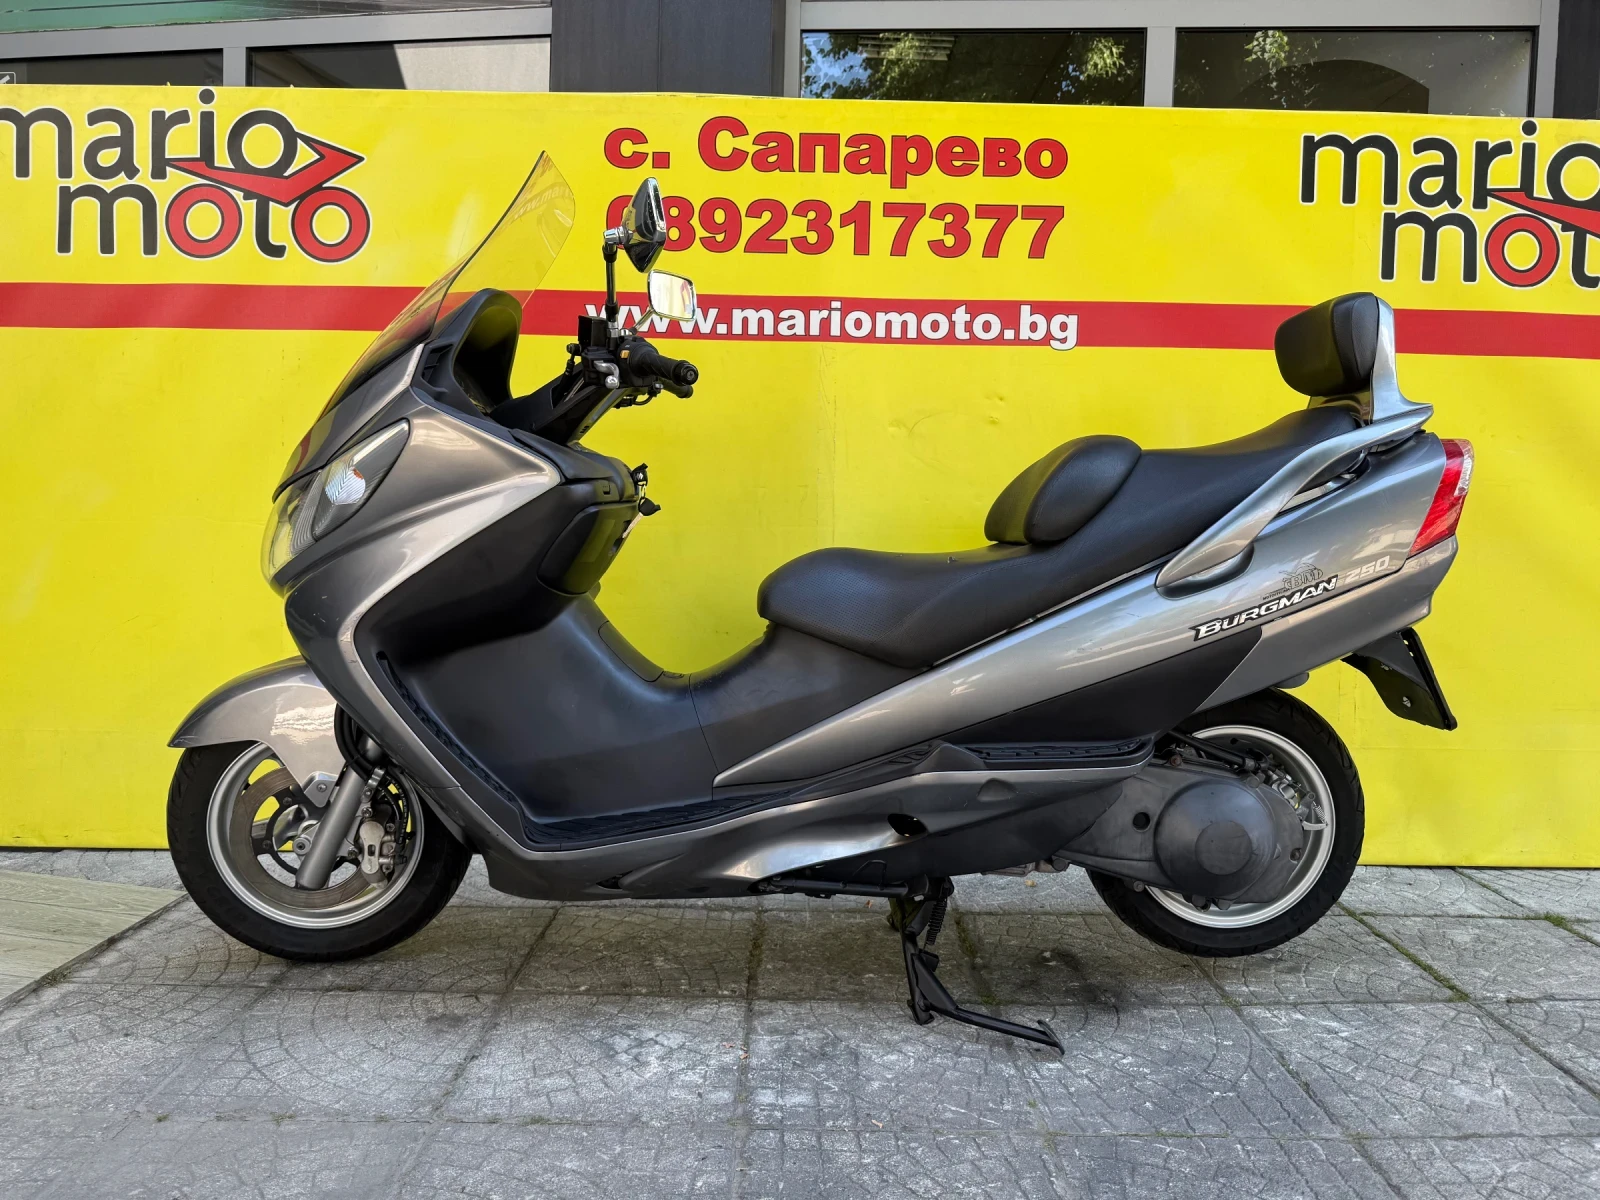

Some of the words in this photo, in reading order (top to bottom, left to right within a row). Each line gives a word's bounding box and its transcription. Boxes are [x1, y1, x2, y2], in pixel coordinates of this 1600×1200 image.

[0, 88, 298, 181] mario
[603, 127, 671, 169] с.
[698, 116, 1069, 189] Сапарево
[1300, 120, 1600, 209] mario
[57, 182, 370, 262] moto
[1345, 556, 1390, 585] 250
